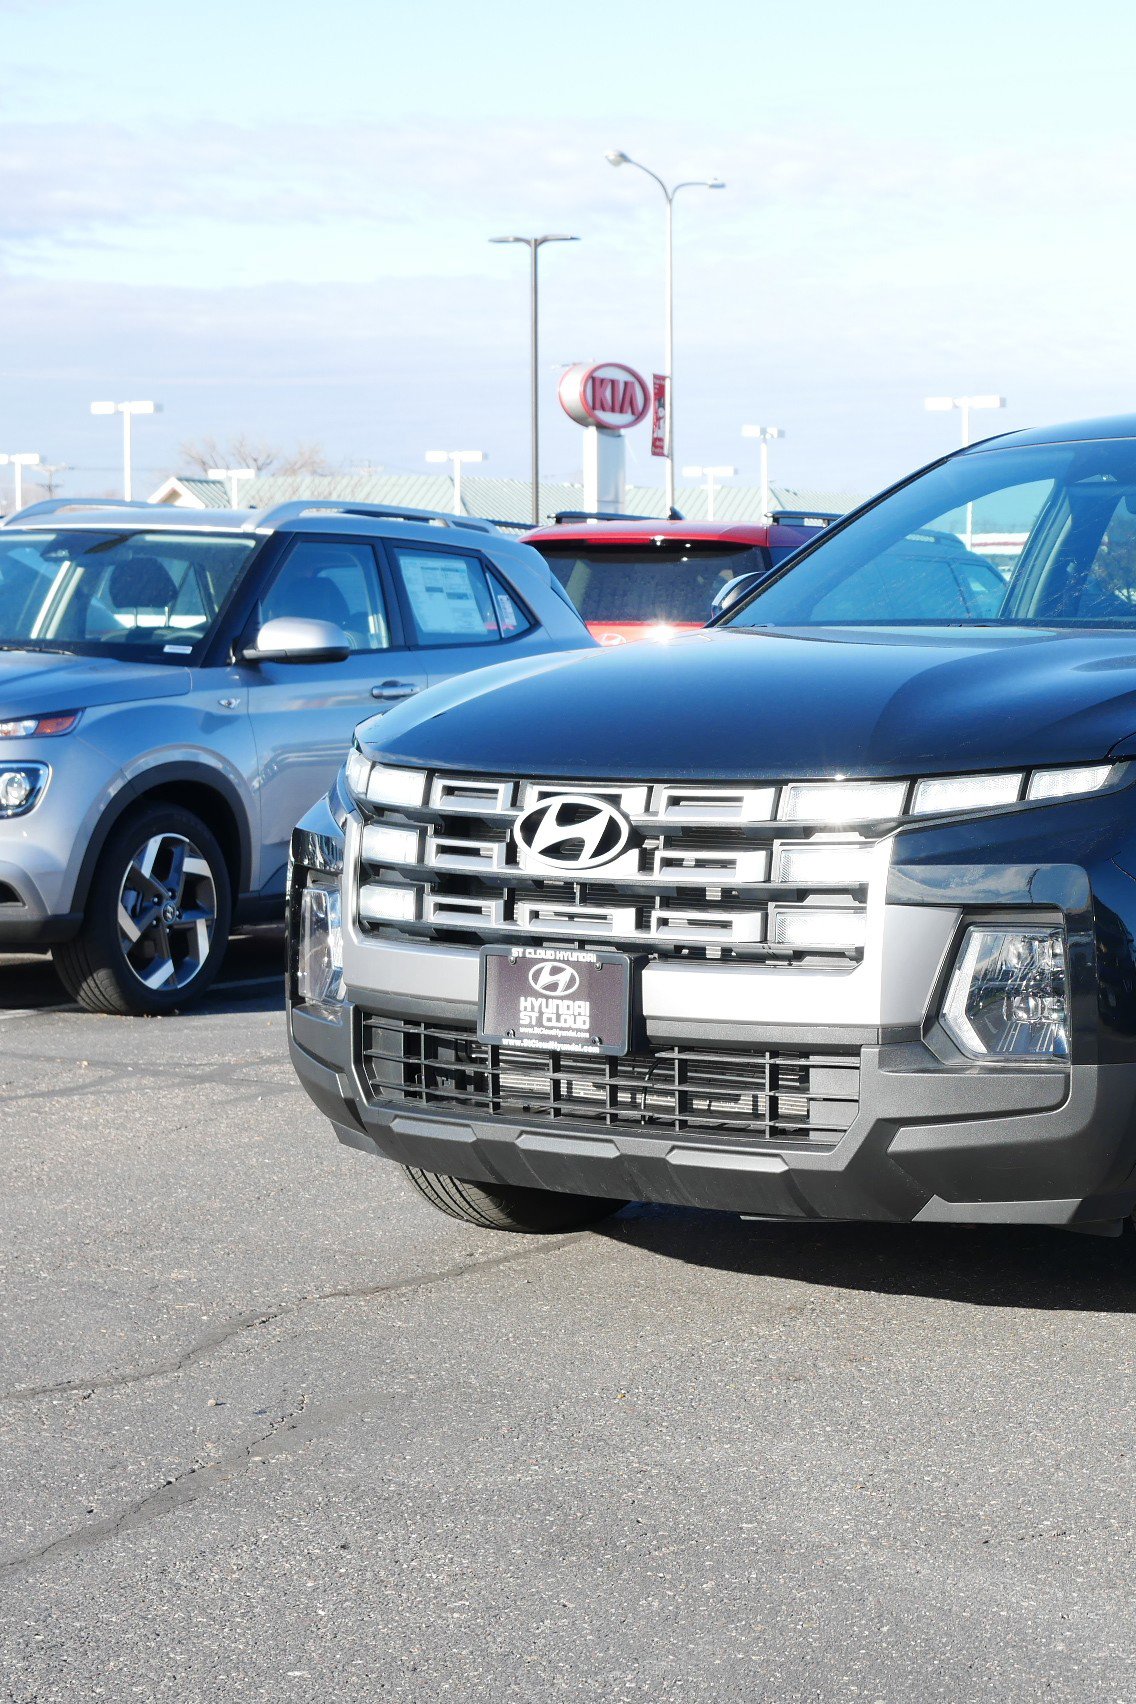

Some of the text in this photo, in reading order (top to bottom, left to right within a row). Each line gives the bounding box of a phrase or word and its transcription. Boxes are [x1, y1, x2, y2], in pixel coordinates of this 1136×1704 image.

[591, 377, 640, 417] KIA
[511, 947, 597, 963] ST CLOUD HYUNDAI
[520, 996, 590, 1016] HYUNDAI
[520, 1011, 590, 1029] ST CLOUD
